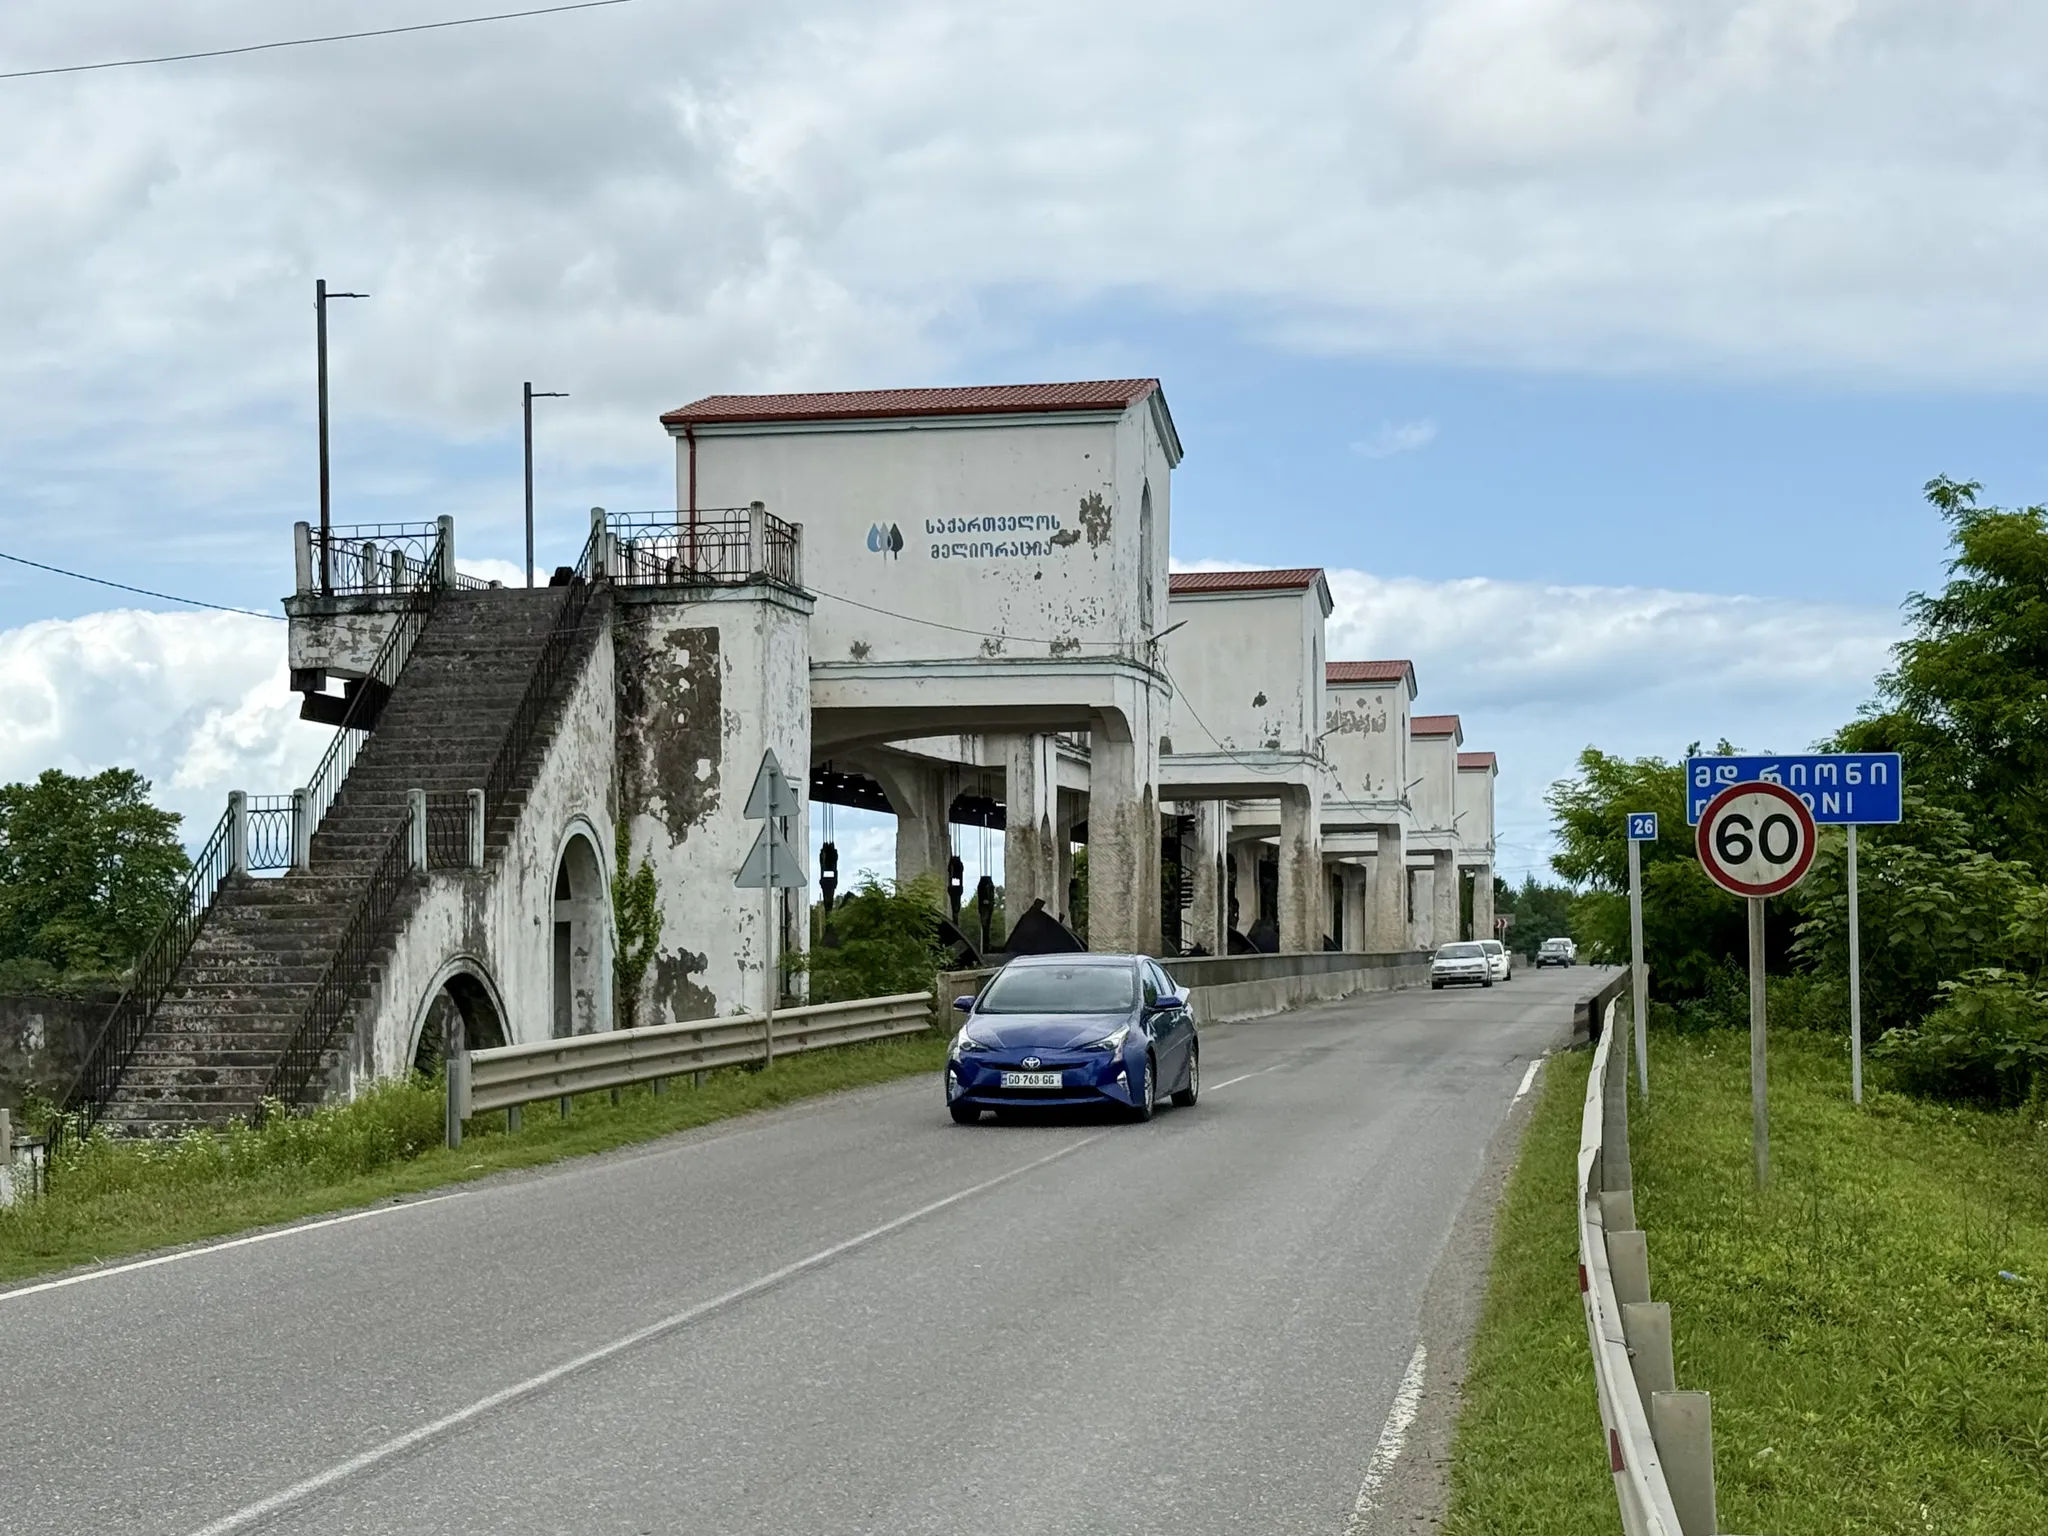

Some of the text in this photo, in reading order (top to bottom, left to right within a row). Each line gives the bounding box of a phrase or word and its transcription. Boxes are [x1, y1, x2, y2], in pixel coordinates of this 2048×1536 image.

[925, 514, 1061, 534] საქართველოს
[930, 540, 1052, 559] მელიორაცია
[1758, 762, 1888, 786] რიონი
[1799, 792, 1853, 815] ONI
[1633, 818, 1654, 835] 26
[1715, 813, 1799, 865] 60
